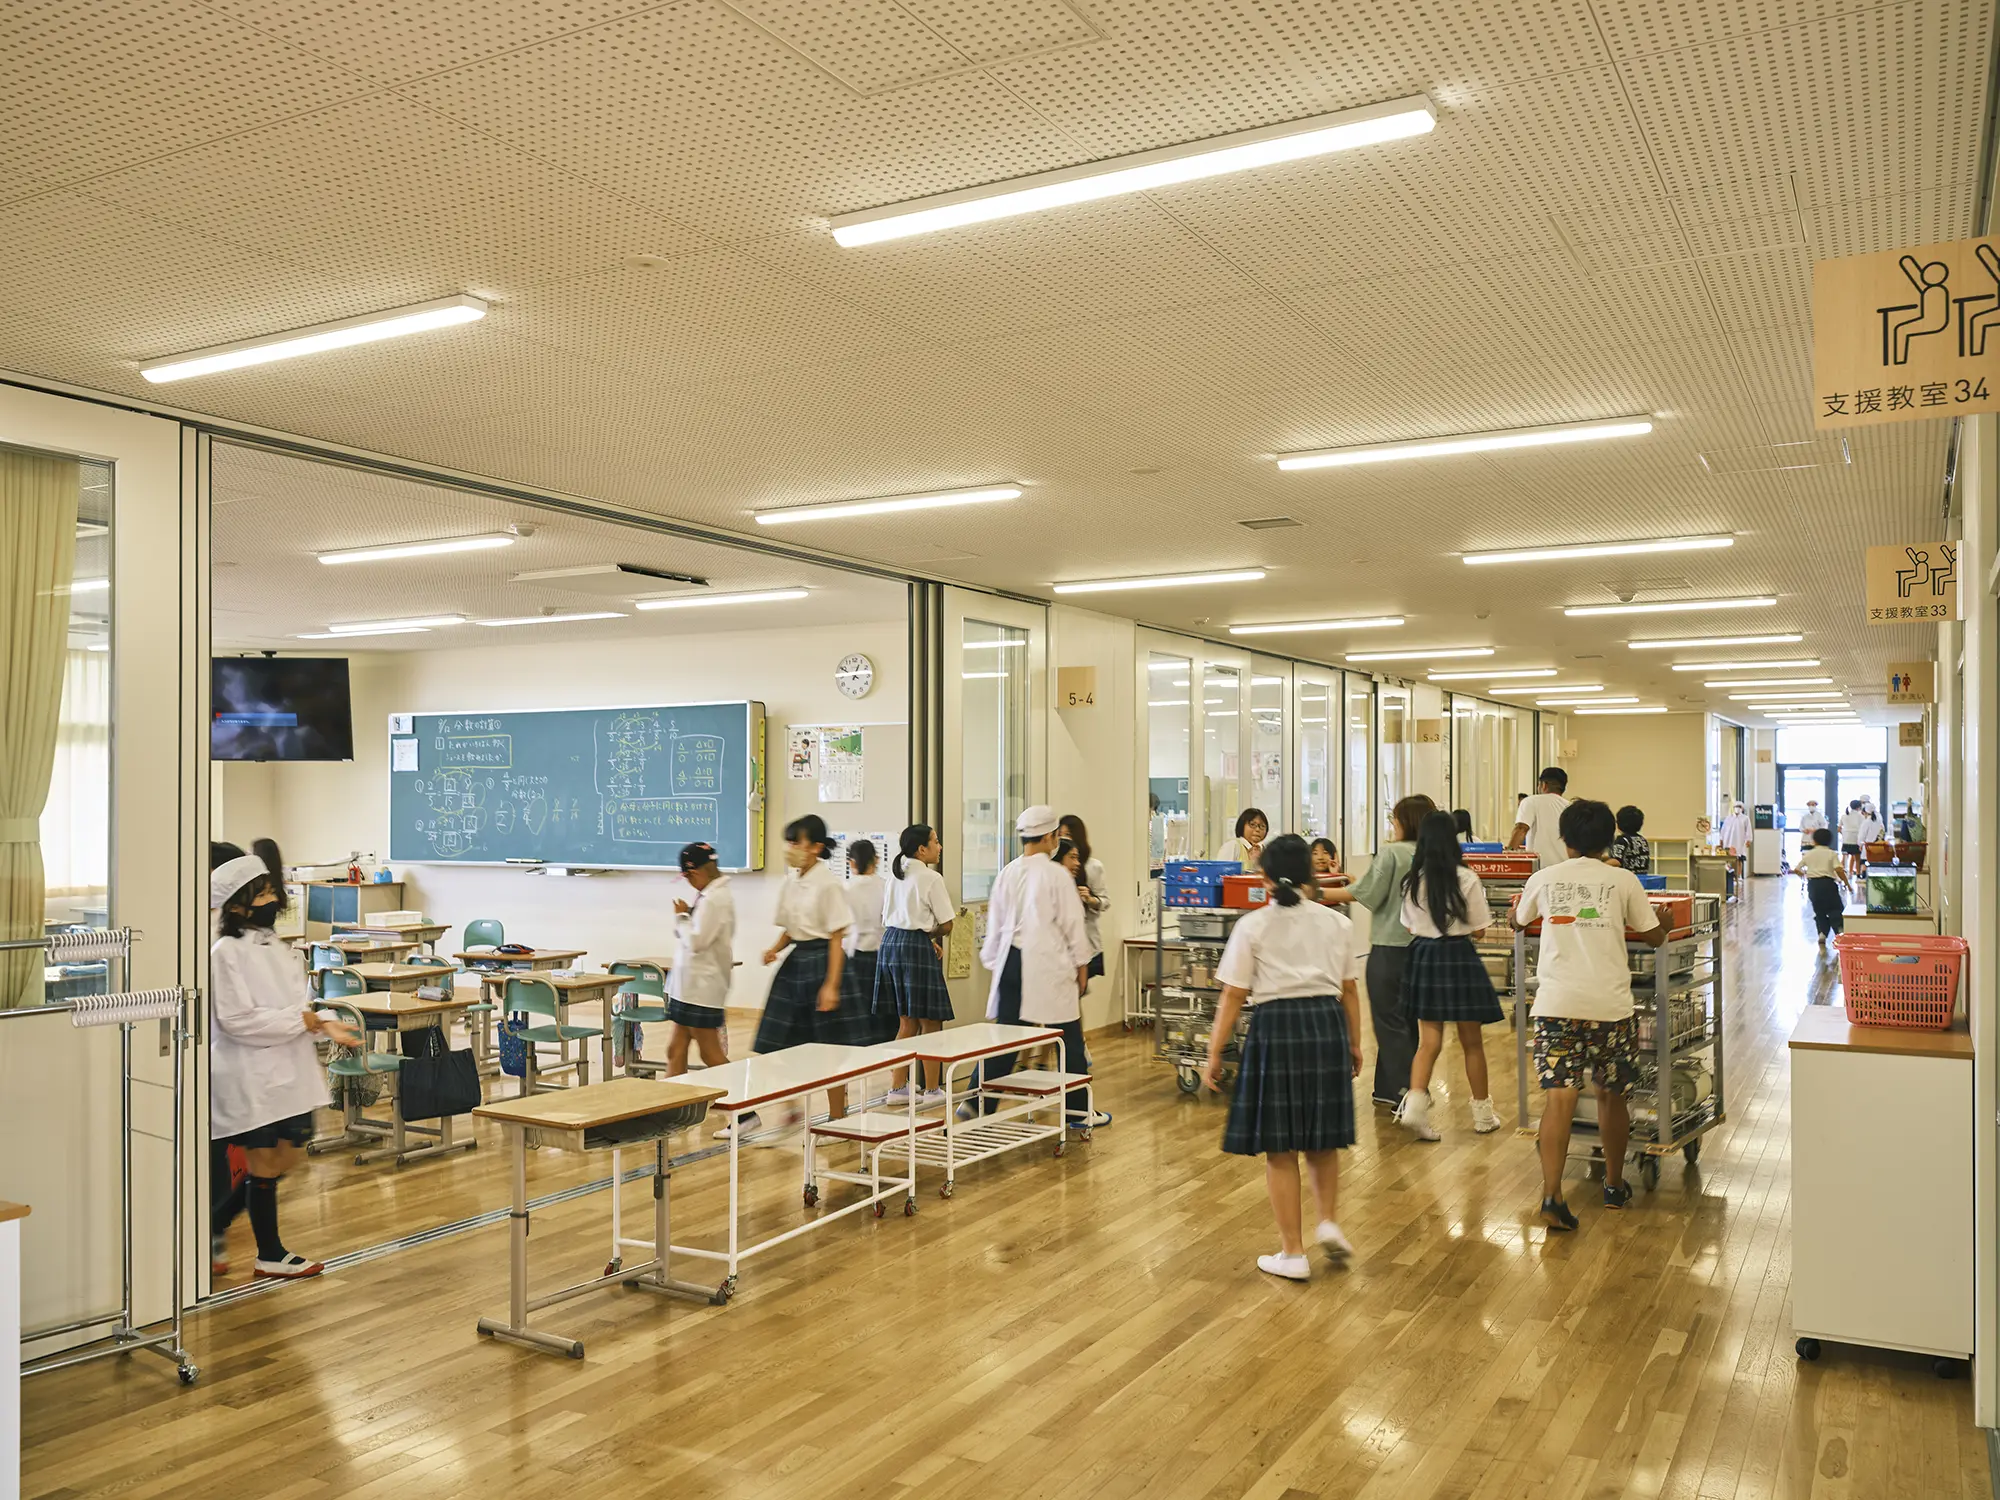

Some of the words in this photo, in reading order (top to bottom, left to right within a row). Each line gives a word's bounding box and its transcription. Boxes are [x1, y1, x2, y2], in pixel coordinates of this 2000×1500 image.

[1822, 376, 1990, 418] 支援教室34
[1870, 604, 1947, 619] 支援教室33
[1068, 692, 1094, 706] 5-4
[1423, 733, 1440, 742] 5-3
